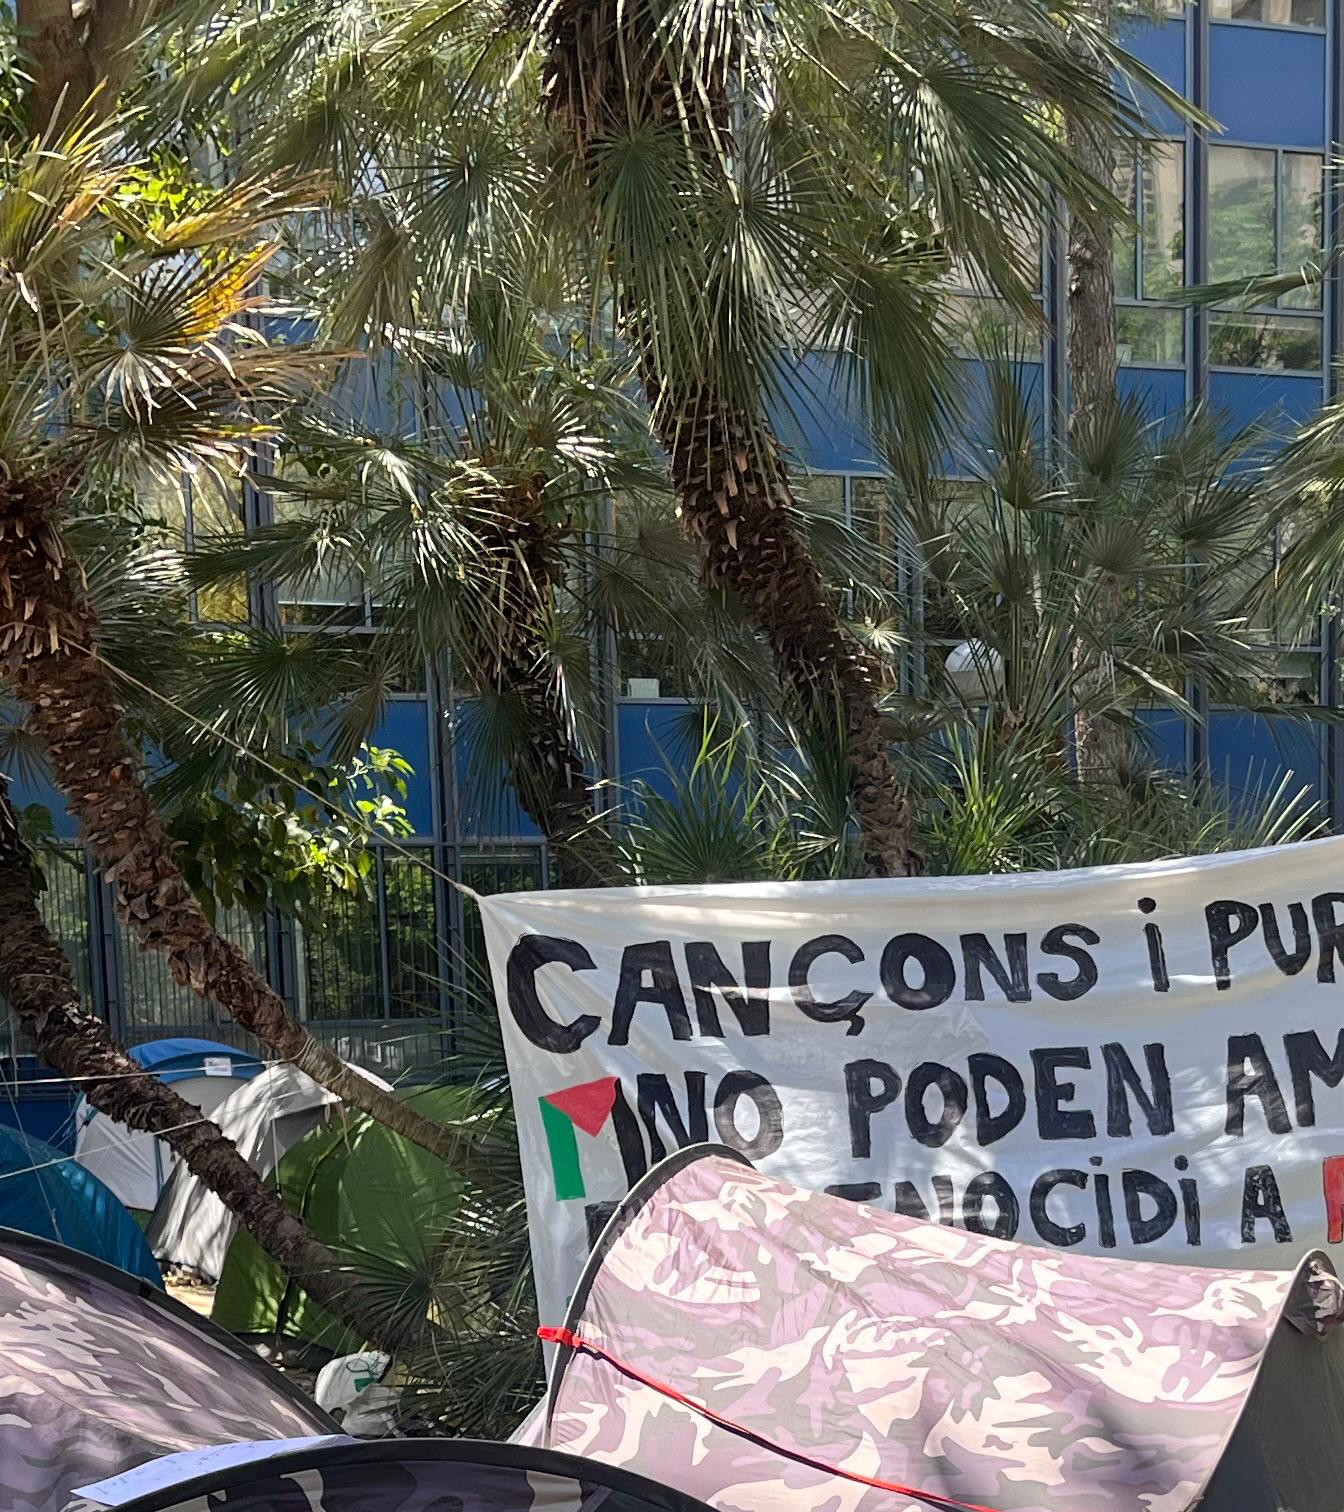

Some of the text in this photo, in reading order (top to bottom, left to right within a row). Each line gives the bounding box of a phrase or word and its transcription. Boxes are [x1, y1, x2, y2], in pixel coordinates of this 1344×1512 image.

[506, 922, 1100, 1054] CANÇONS
[637, 1071, 782, 1161] NO
[844, 1042, 1175, 1159] PODEN
[1240, 1166, 1294, 1246] A
